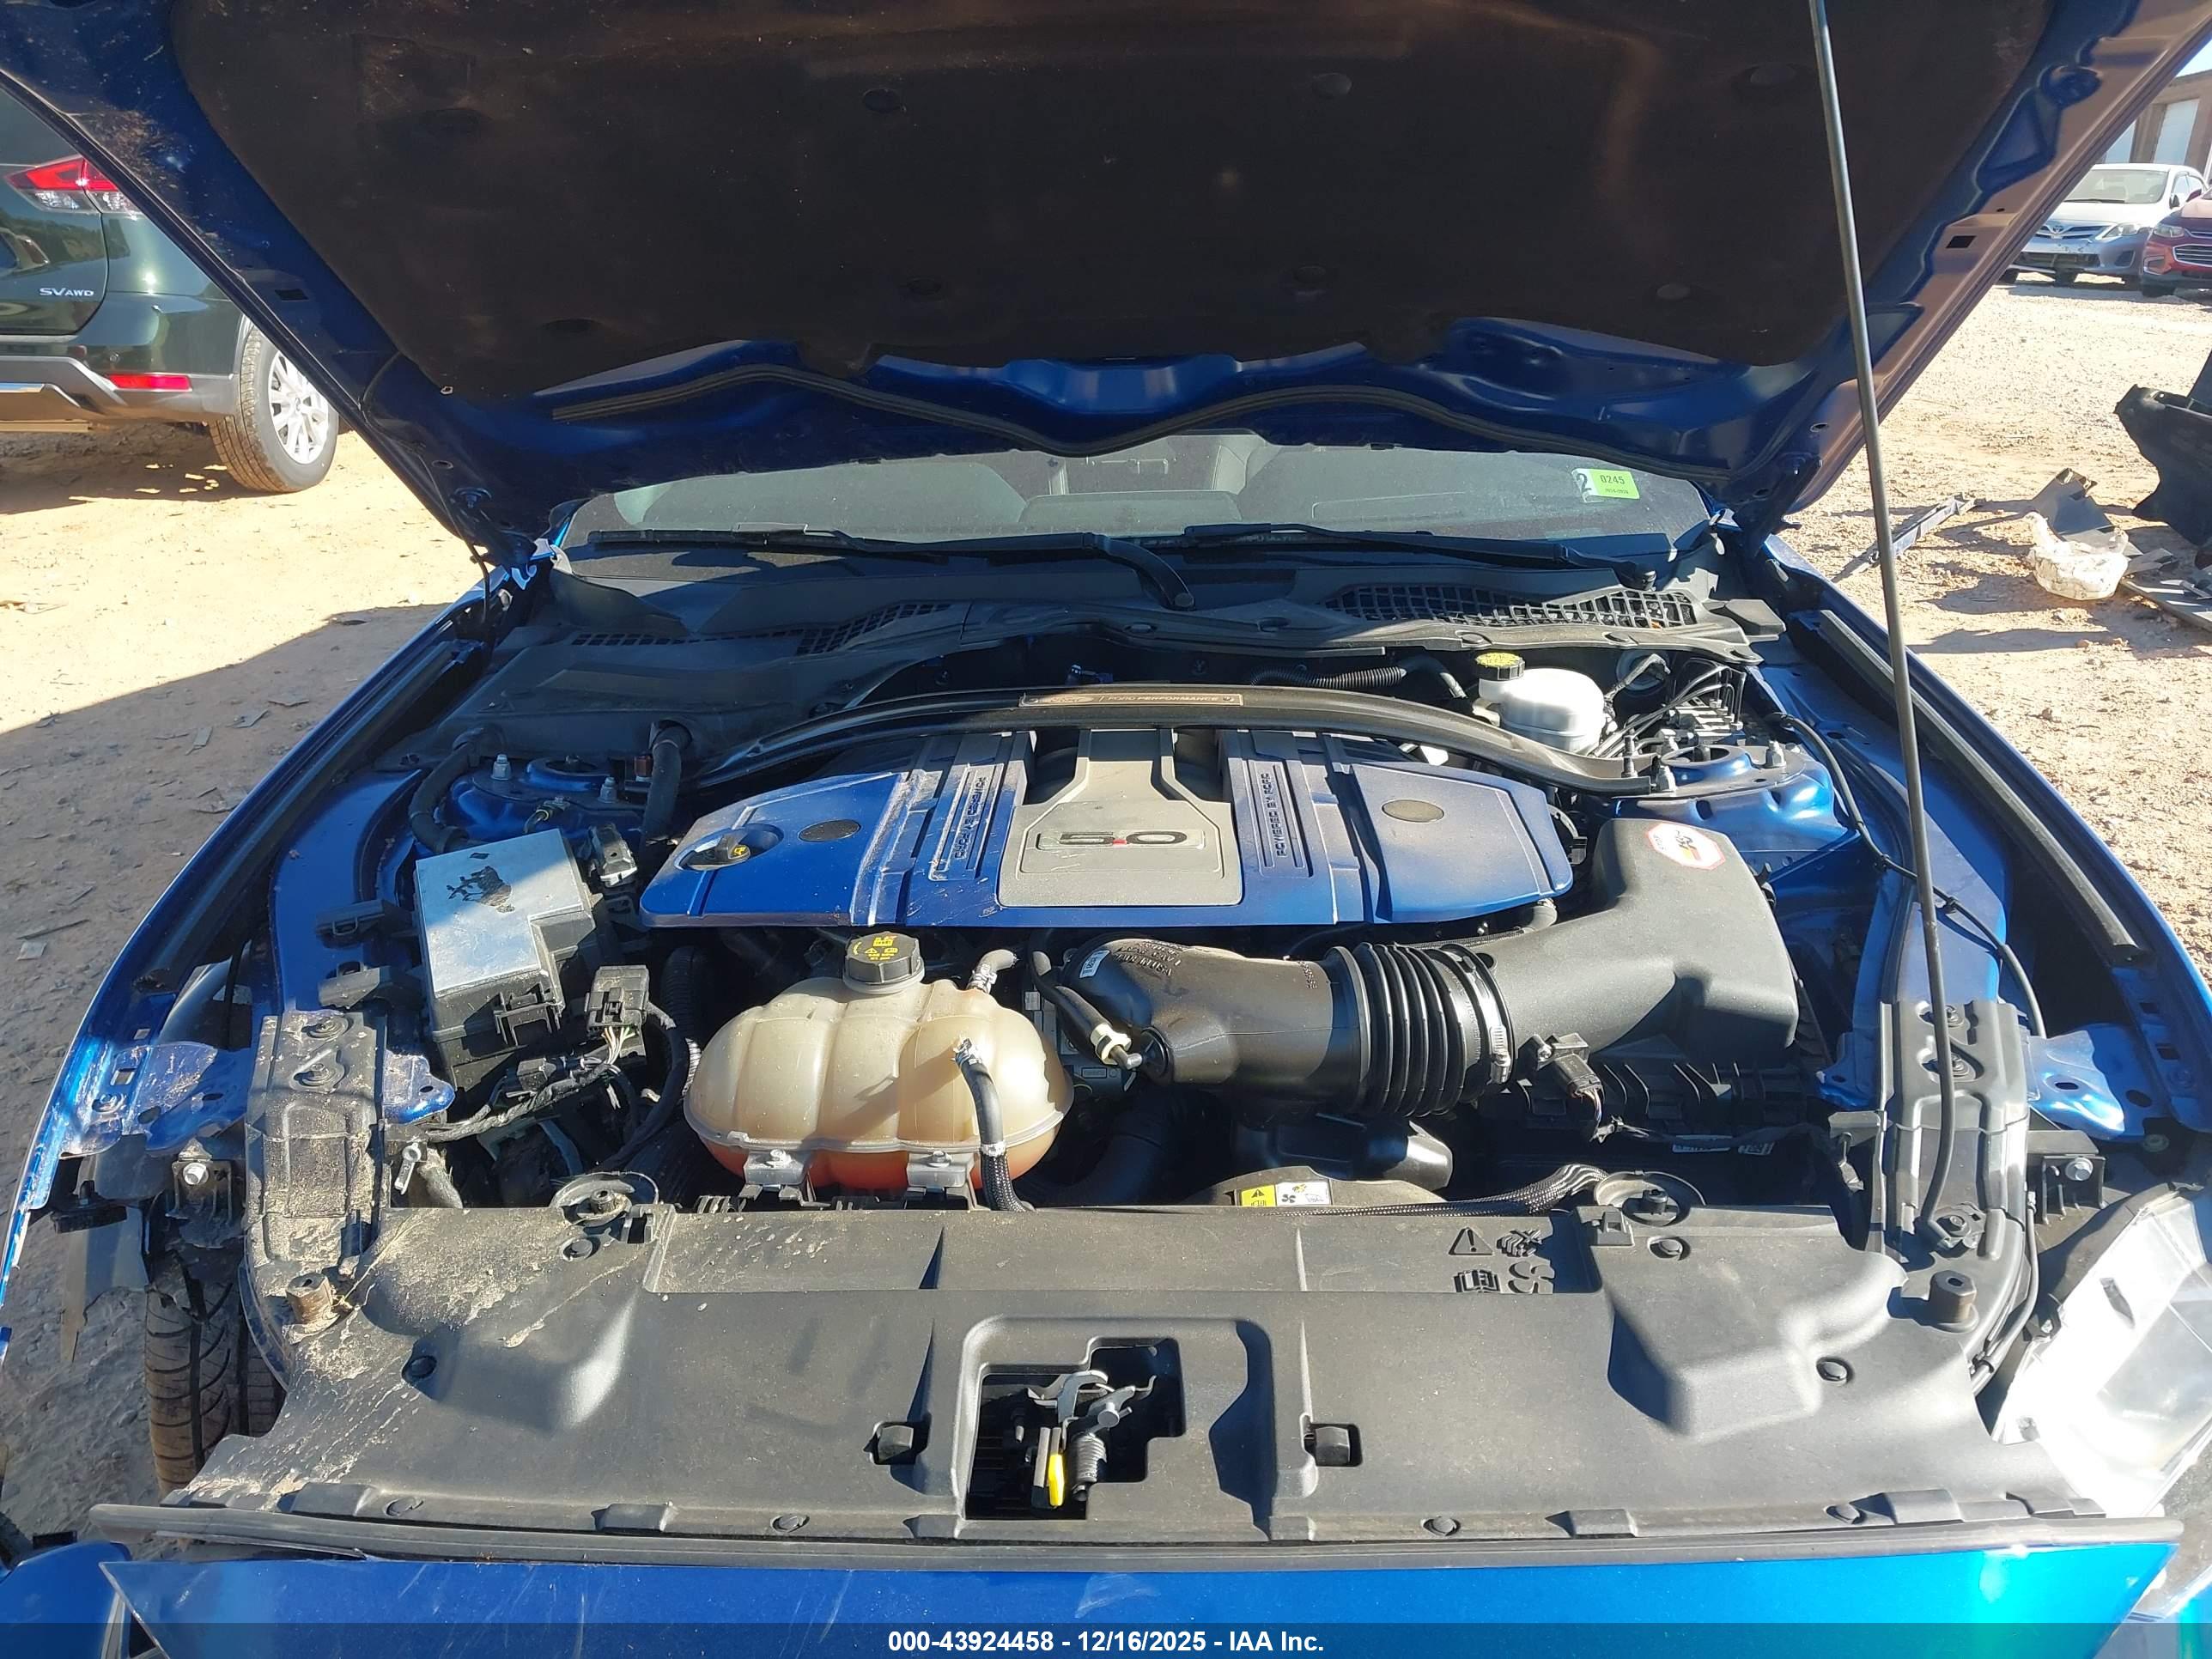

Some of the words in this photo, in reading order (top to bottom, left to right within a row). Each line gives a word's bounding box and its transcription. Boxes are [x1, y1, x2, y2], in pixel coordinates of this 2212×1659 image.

[1600, 474, 1626, 485] 0245
[1260, 772, 1273, 796] FORD
[966, 776, 988, 817] POWERED
[1265, 796, 1277, 810] BY
[954, 831, 972, 860] FORD
[1059, 830, 1188, 846] 5.0
[1268, 810, 1287, 858] POWERED
